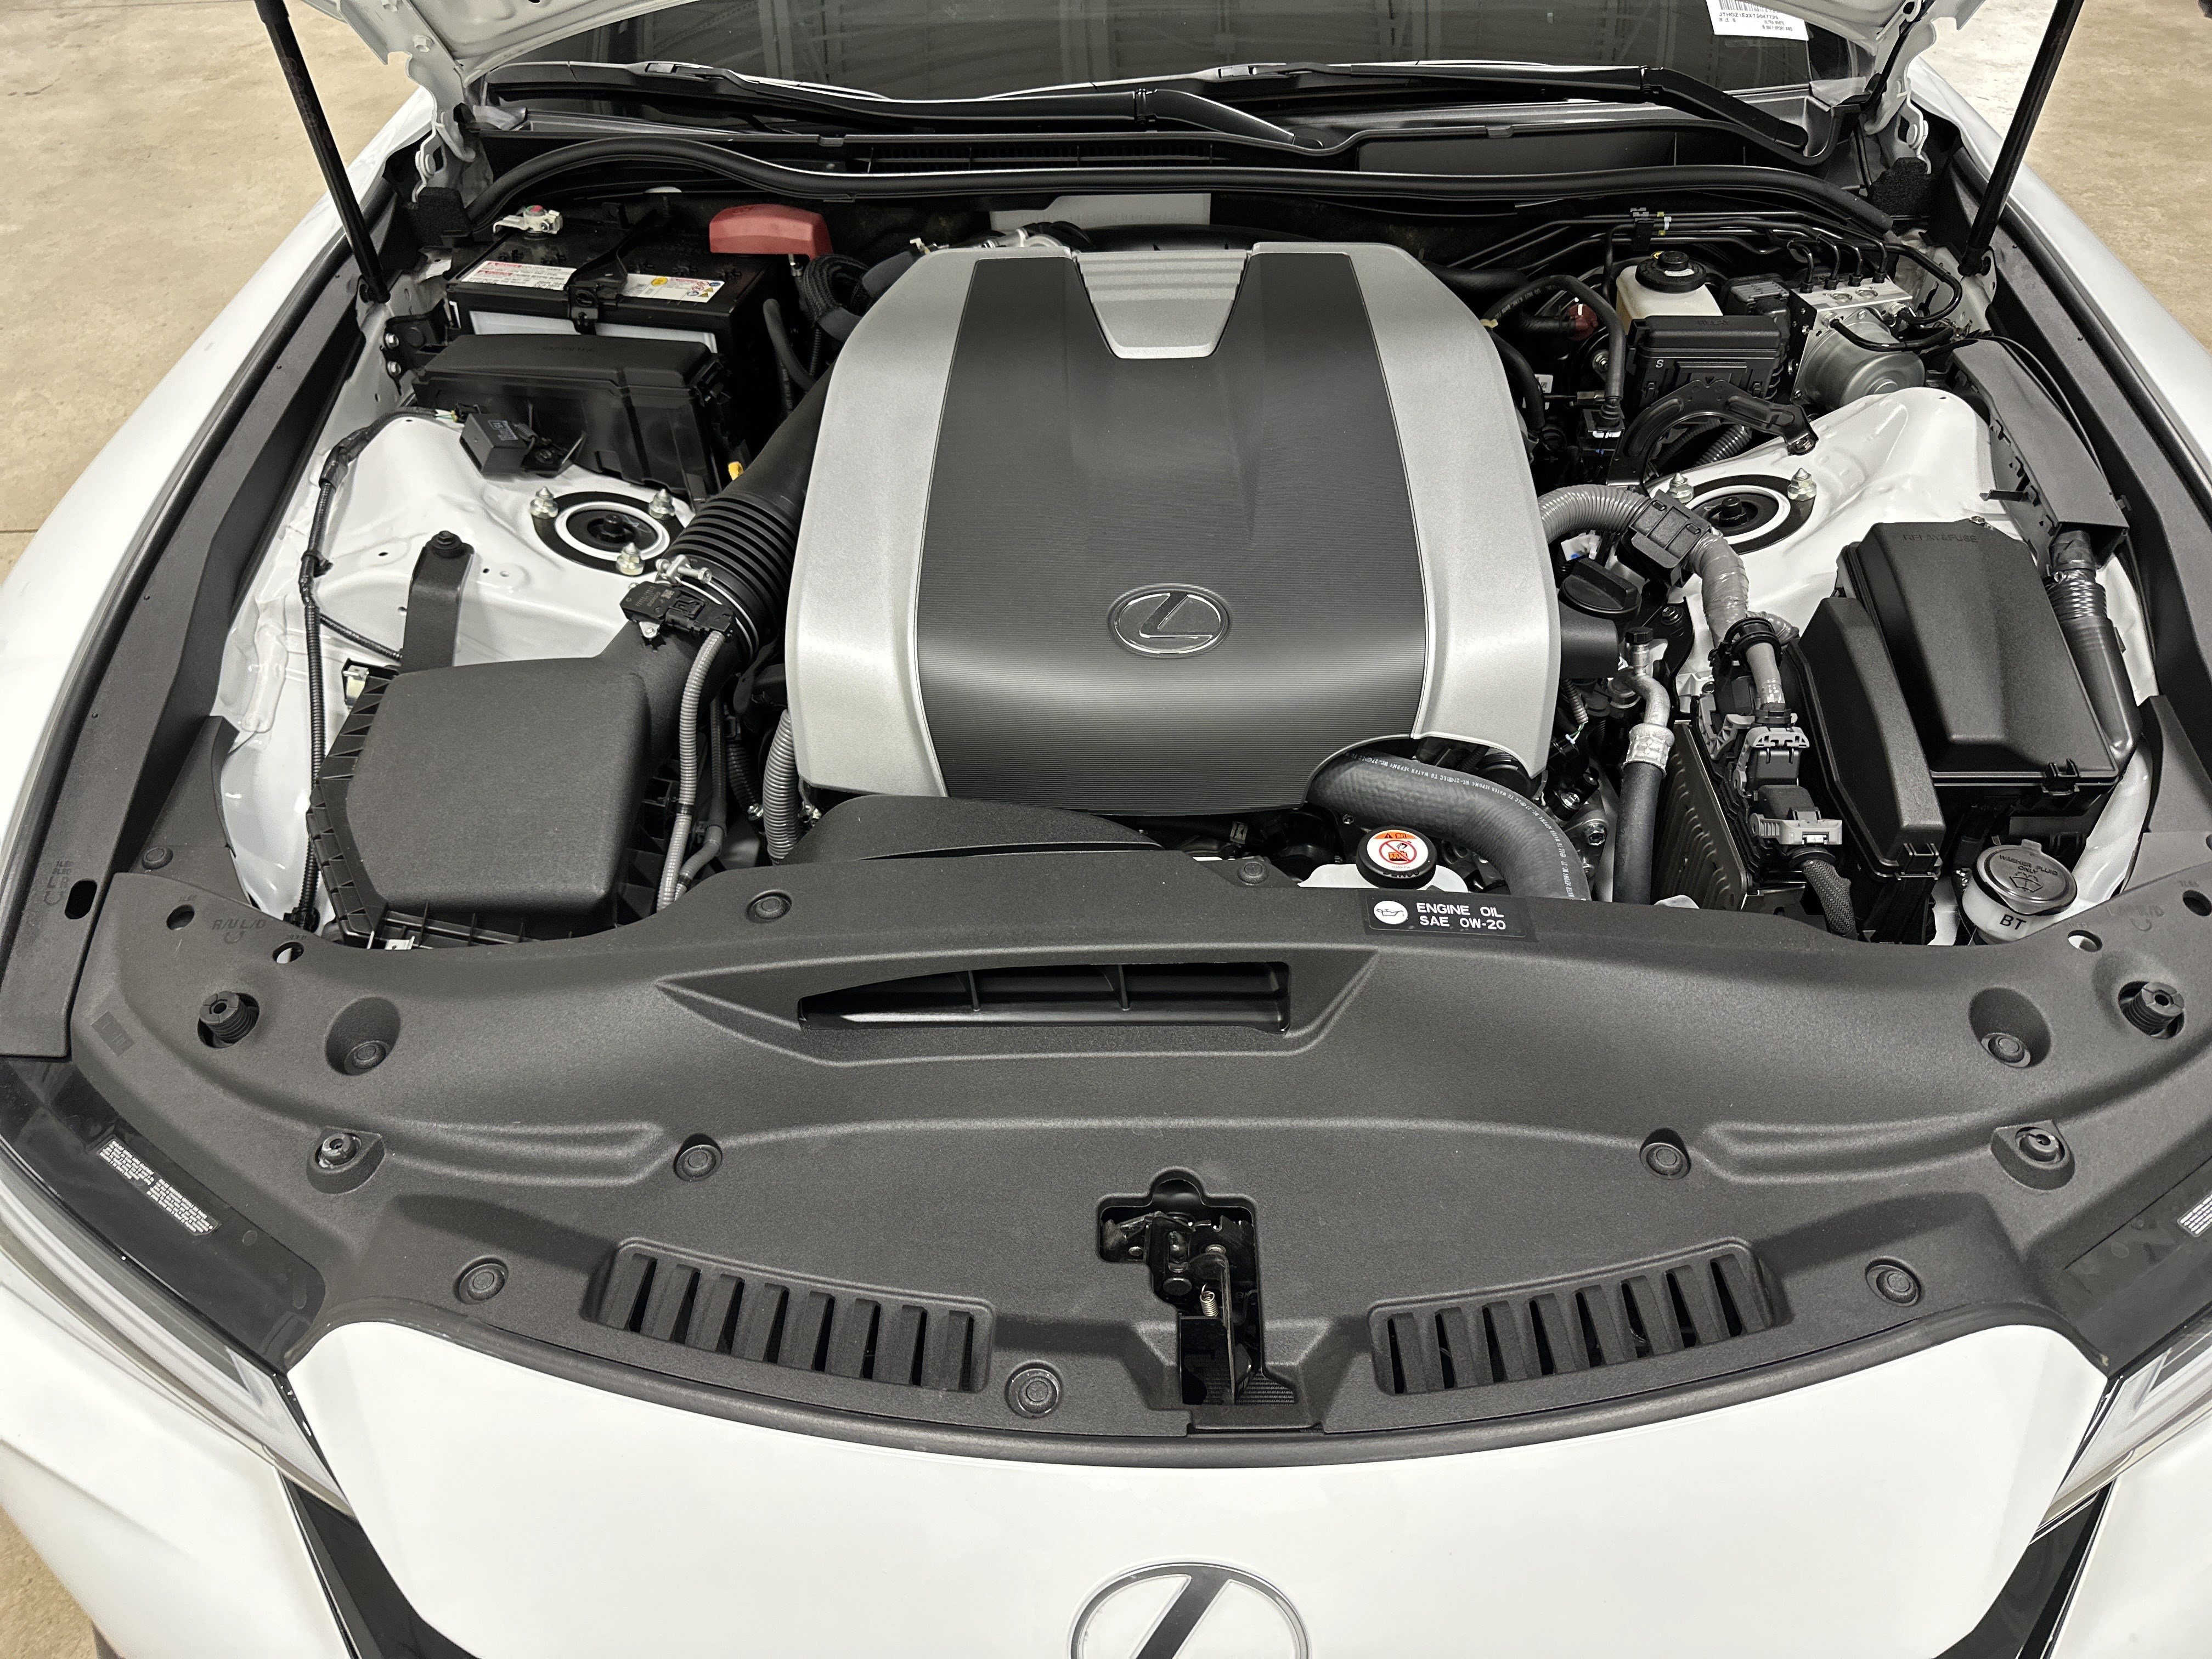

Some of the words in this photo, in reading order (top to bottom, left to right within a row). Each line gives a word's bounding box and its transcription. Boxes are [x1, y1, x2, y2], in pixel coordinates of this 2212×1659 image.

[1655, 359, 1664, 368] S
[2018, 865, 2038, 874] ONLY
[1416, 902, 1471, 916] ENGINE
[1480, 906, 1504, 918] OIL
[1419, 916, 1450, 927] SAE
[1459, 917, 1506, 930] 0W-20
[2000, 914, 2027, 930] BT
